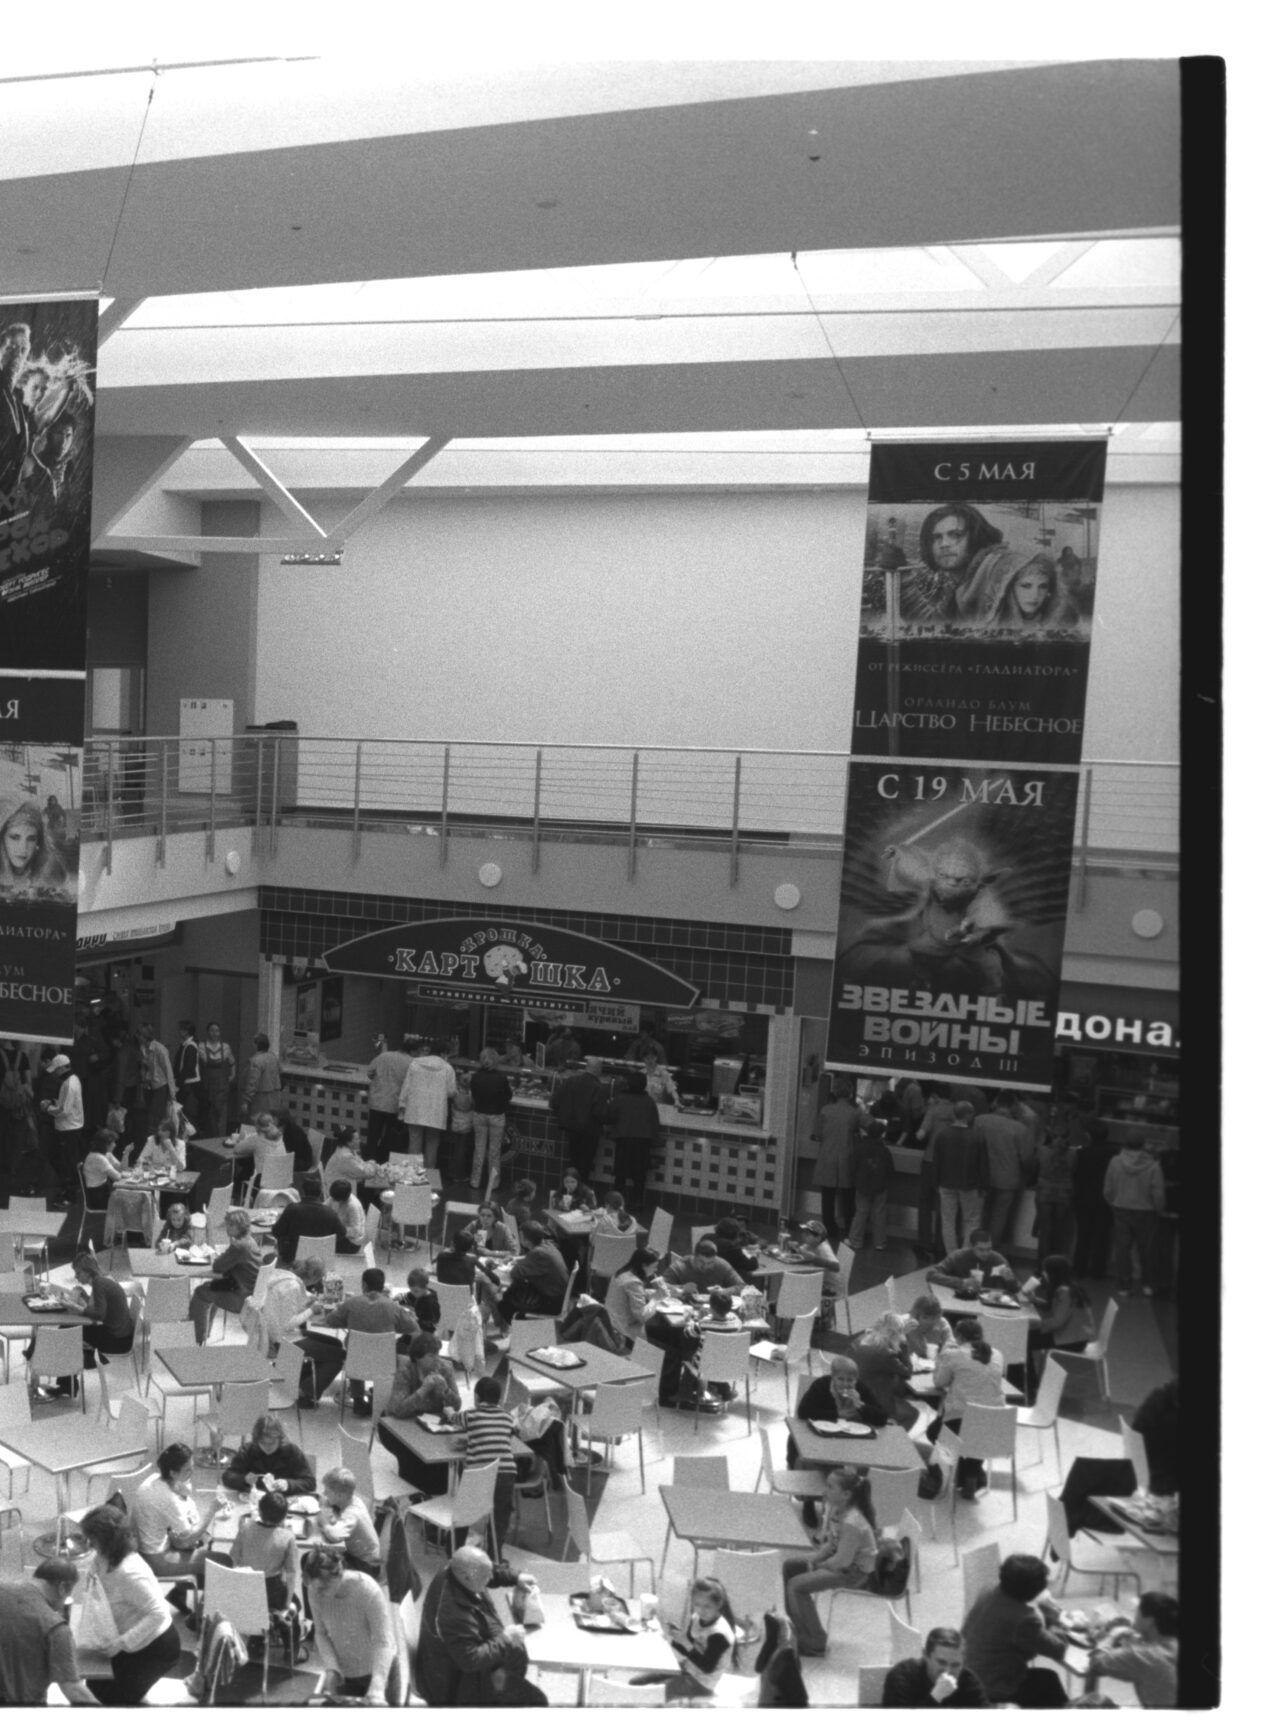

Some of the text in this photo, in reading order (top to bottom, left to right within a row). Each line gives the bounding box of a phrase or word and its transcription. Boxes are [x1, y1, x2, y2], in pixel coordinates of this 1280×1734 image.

[933, 461, 1036, 481] С 5 МАЯ
[888, 663, 962, 674] РЕЖИССЕРА
[904, 696, 1033, 712] ОРЛАНДО БЛУМ
[855, 709, 1082, 735] ЦАРСТВО НЕБЕСНОЕ
[877, 774, 1047, 807] С 19 МАЯ
[461, 927, 544, 960] КРОШКА
[837, 983, 1052, 1028] ЗВЕЗДНЫЕ
[862, 1014, 1020, 1056] ВОЙНЫ
[1054, 1010, 1181, 1049] дона
[857, 1044, 1019, 1073] ЭПИЗОД III
